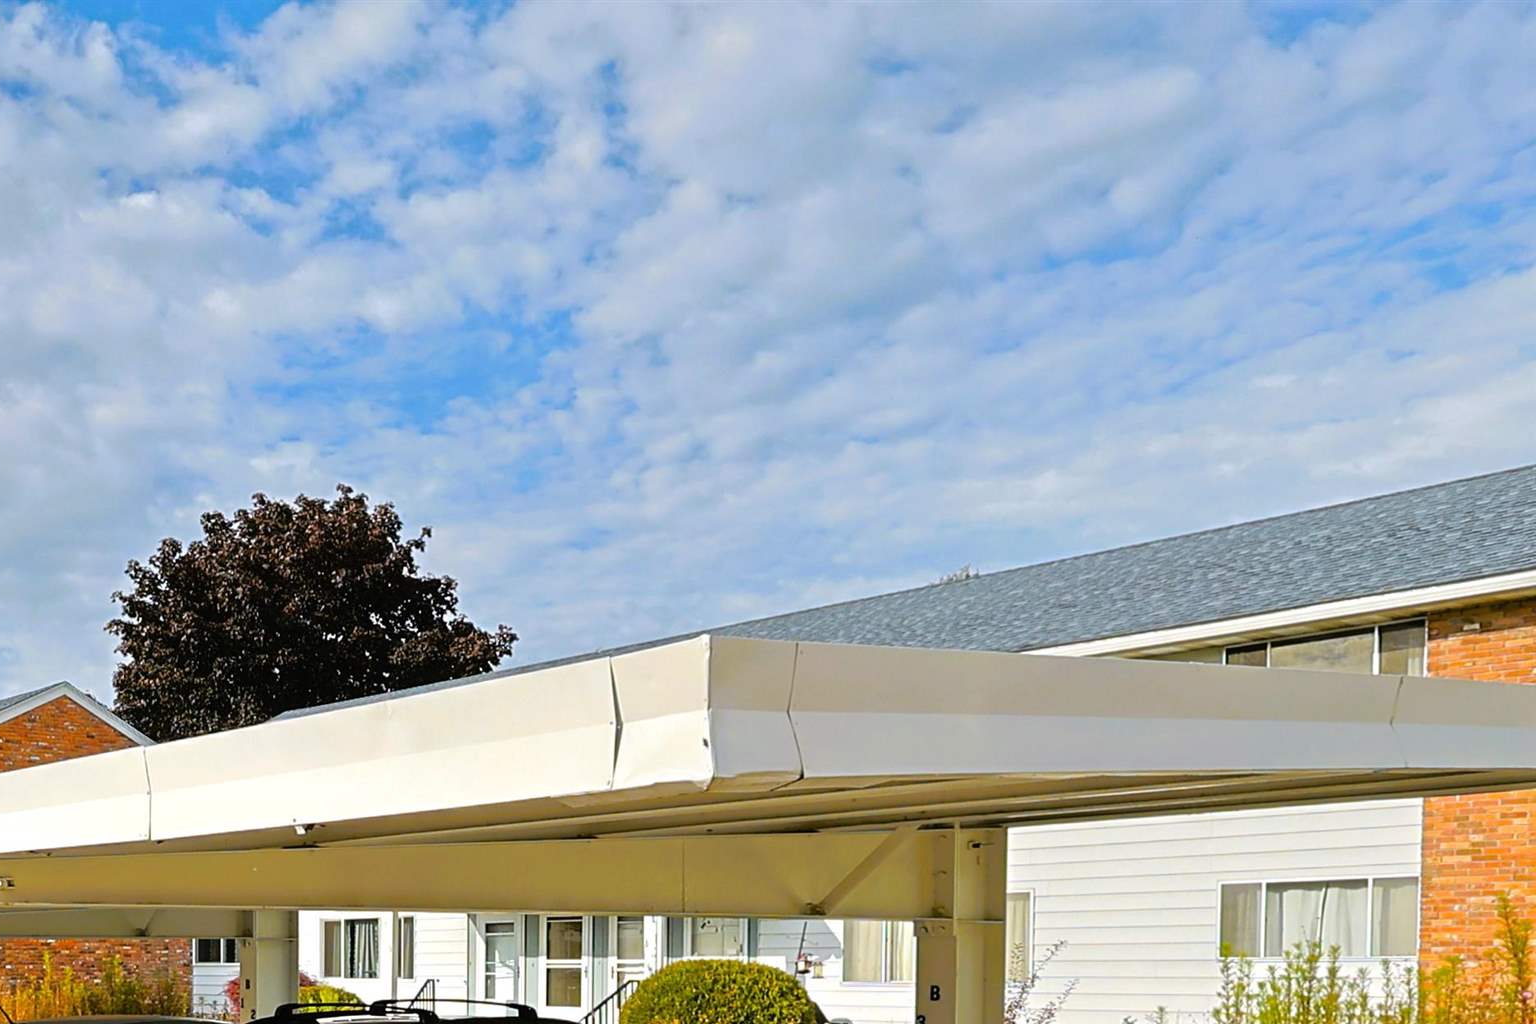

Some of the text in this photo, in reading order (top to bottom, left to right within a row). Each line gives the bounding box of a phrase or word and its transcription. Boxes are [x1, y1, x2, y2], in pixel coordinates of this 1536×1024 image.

[245, 979, 251, 990] B
[930, 985, 941, 1001] B
[250, 1009, 256, 1020] 2
